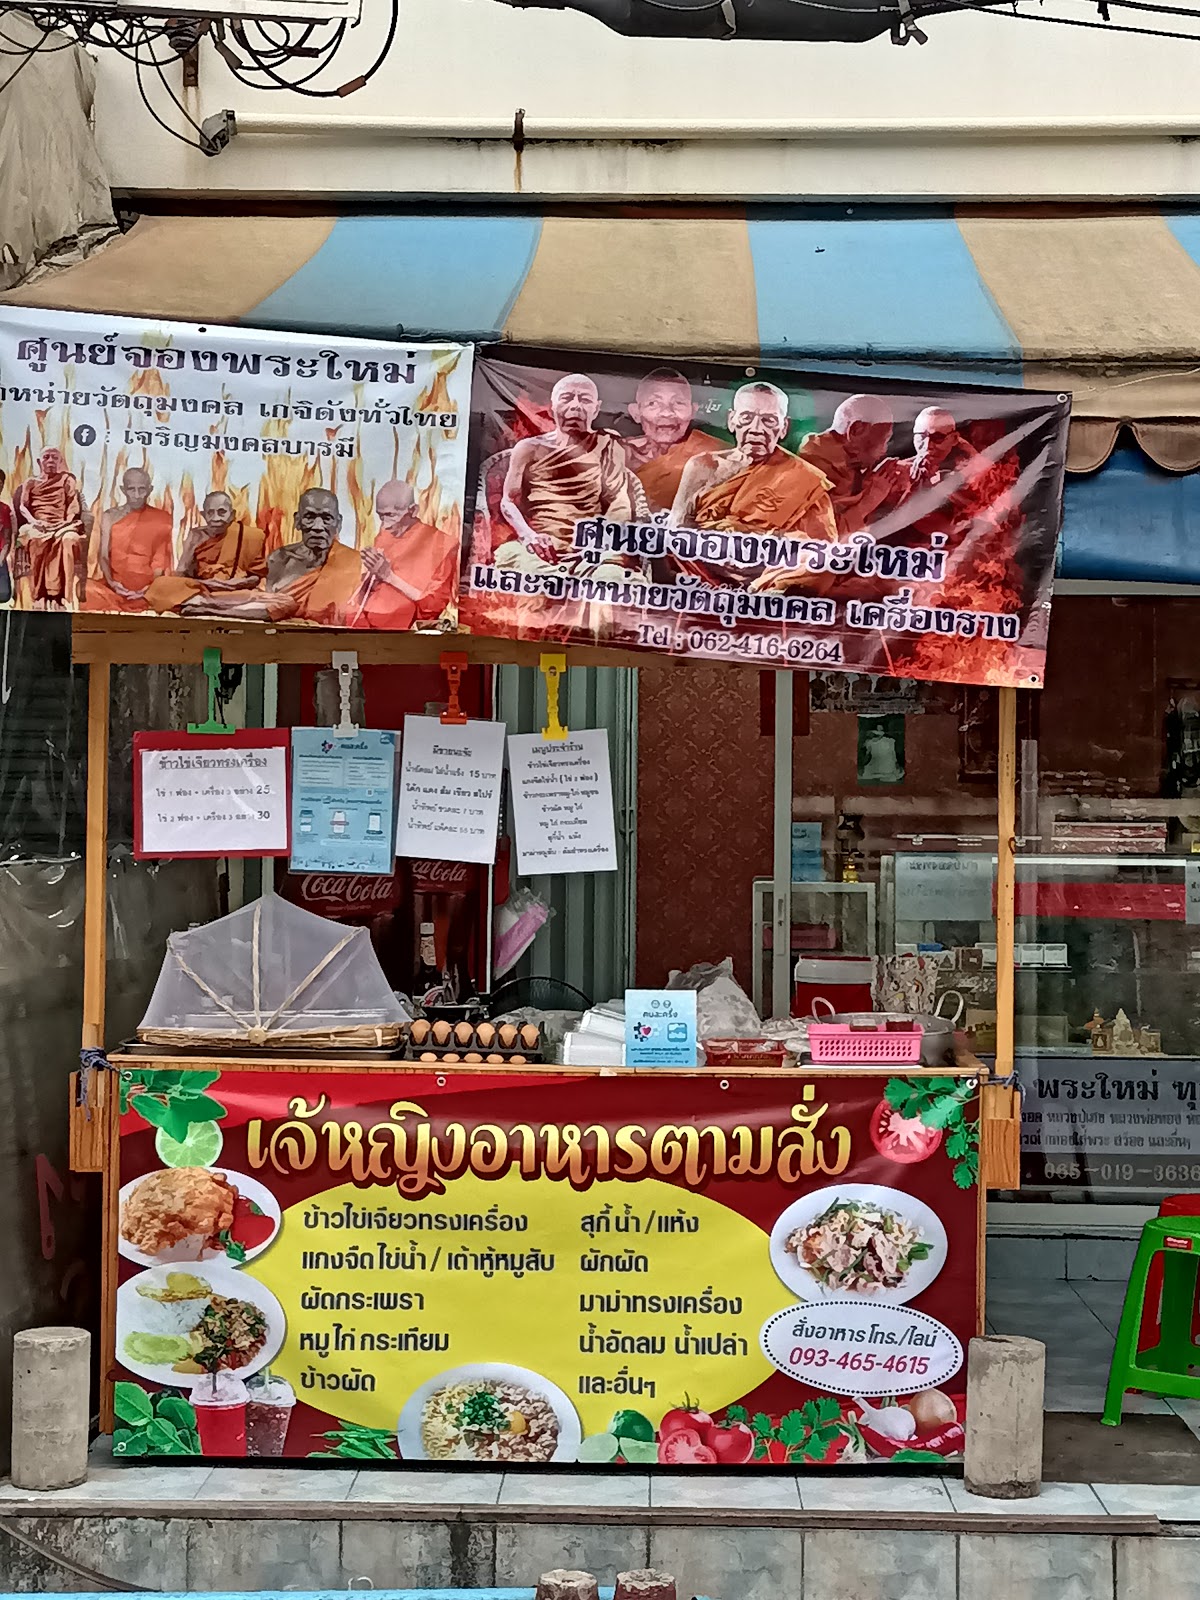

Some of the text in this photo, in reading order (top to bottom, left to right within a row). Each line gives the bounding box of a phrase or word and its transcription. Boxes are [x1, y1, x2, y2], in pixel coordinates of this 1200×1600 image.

[17, 333, 417, 384] ศูนย์จองพระใหม่
[260, 398, 457, 428] เกจิดังทั่วไทย
[125, 426, 354, 457] เจริญมงคลบารมี
[575, 512, 947, 579] ศูนย์จองพระใหม่
[474, 565, 1020, 639] และจำหน่ายวัตถุมงคล เครื่องราง
[638, 624, 669, 646] Tel
[690, 630, 842, 662] 062-416-6264
[159, 752, 268, 769] ข้าวไข่เจียวทรงเครื่อง
[469, 770, 480, 779] 15
[256, 784, 271, 795] 25
[257, 811, 270, 819] 30
[1036, 1069, 1159, 1101] พระใหม่
[246, 1085, 852, 1194] เจ้หญิงอาหารตามสั่ง
[303, 1202, 528, 1231] ข้าวไข่เจียวทรงเครื่อง
[447, 1246, 555, 1278] เต้าหู้หมูสับ
[580, 1248, 648, 1272] ผักผัด
[301, 1286, 424, 1310] ผัดกระเพรา
[580, 1286, 742, 1314] มาม่าทรงเครื่อง
[579, 1323, 748, 1355] น้ำอัดลม น้ำเปล่า
[789, 1347, 930, 1375] 093-465-4615
[301, 1366, 375, 1391] ข้าวผัด
[579, 1366, 655, 1398] และอื่นๆ
